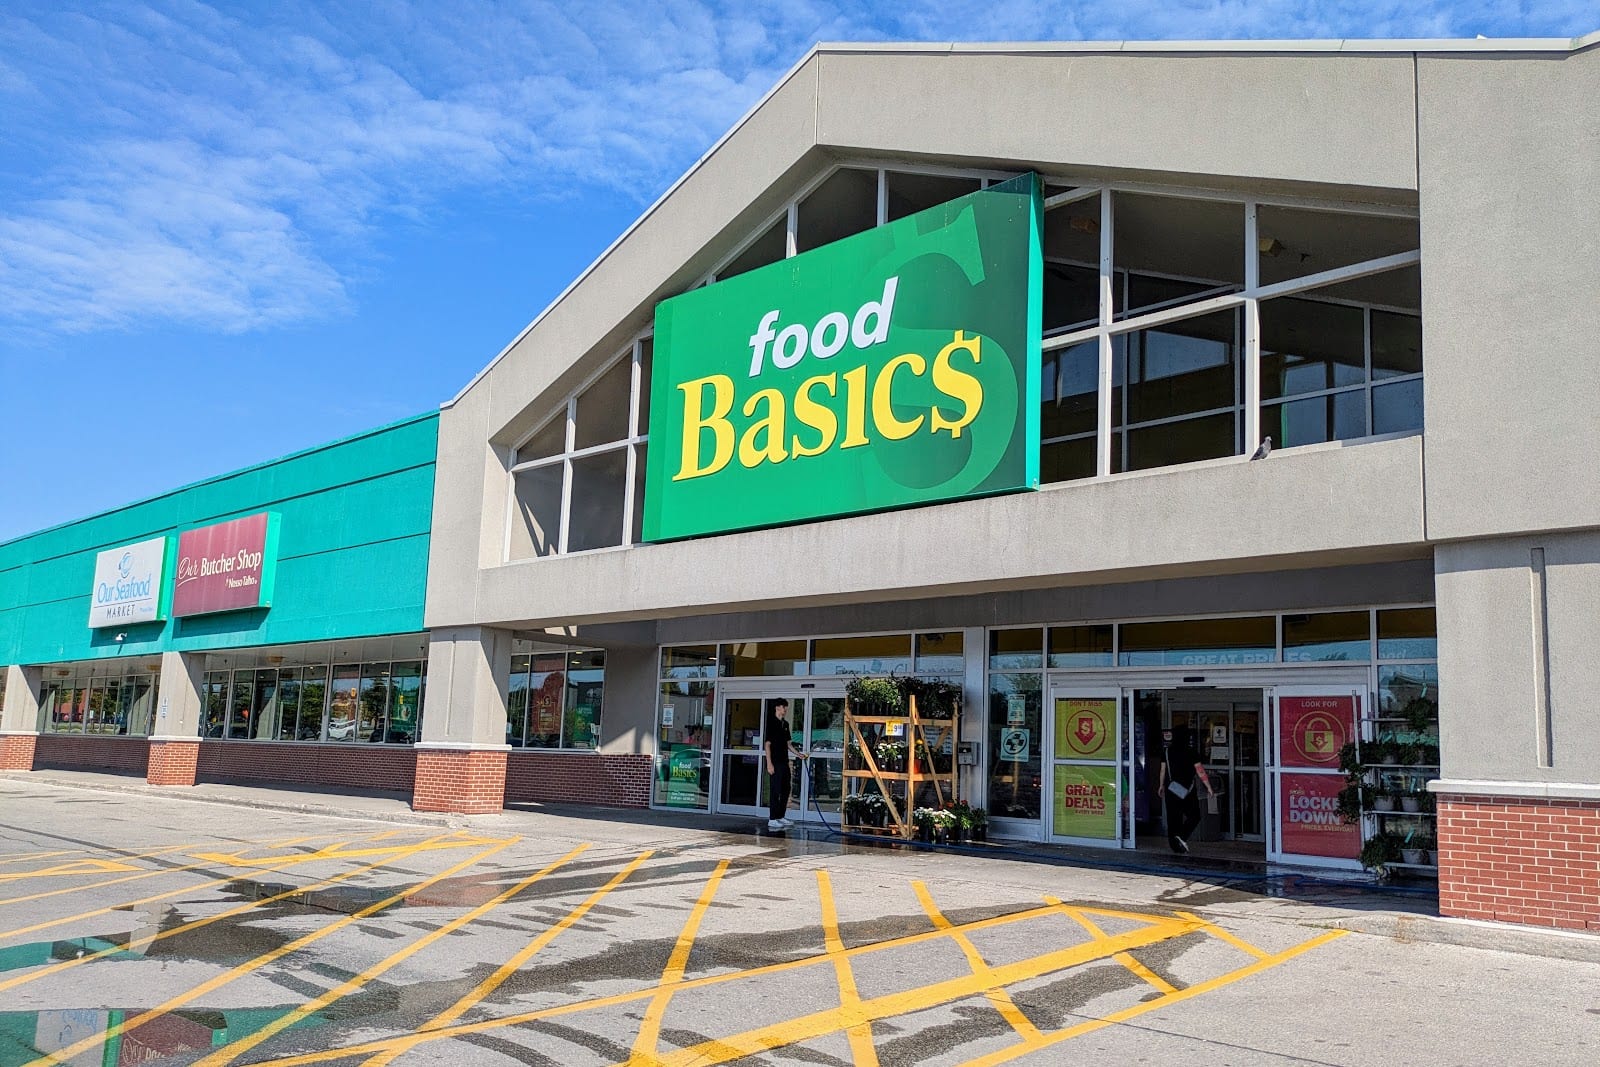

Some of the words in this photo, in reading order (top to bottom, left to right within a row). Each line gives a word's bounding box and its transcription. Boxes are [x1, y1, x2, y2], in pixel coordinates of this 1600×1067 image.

[749, 276, 898, 377] food
[178, 557, 198, 580] Our
[200, 553, 236, 577] Butcher
[236, 548, 261, 571] Shop
[97, 582, 115, 603] Our
[115, 572, 152, 600] Seafood
[107, 604, 135, 619] MARKET
[1301, 700, 1321, 708] LOOK
[1322, 700, 1338, 708] FOR
[1065, 784, 1105, 797] GREAT
[1065, 797, 1106, 810] DEALS
[1289, 810, 1341, 826] DOWN
